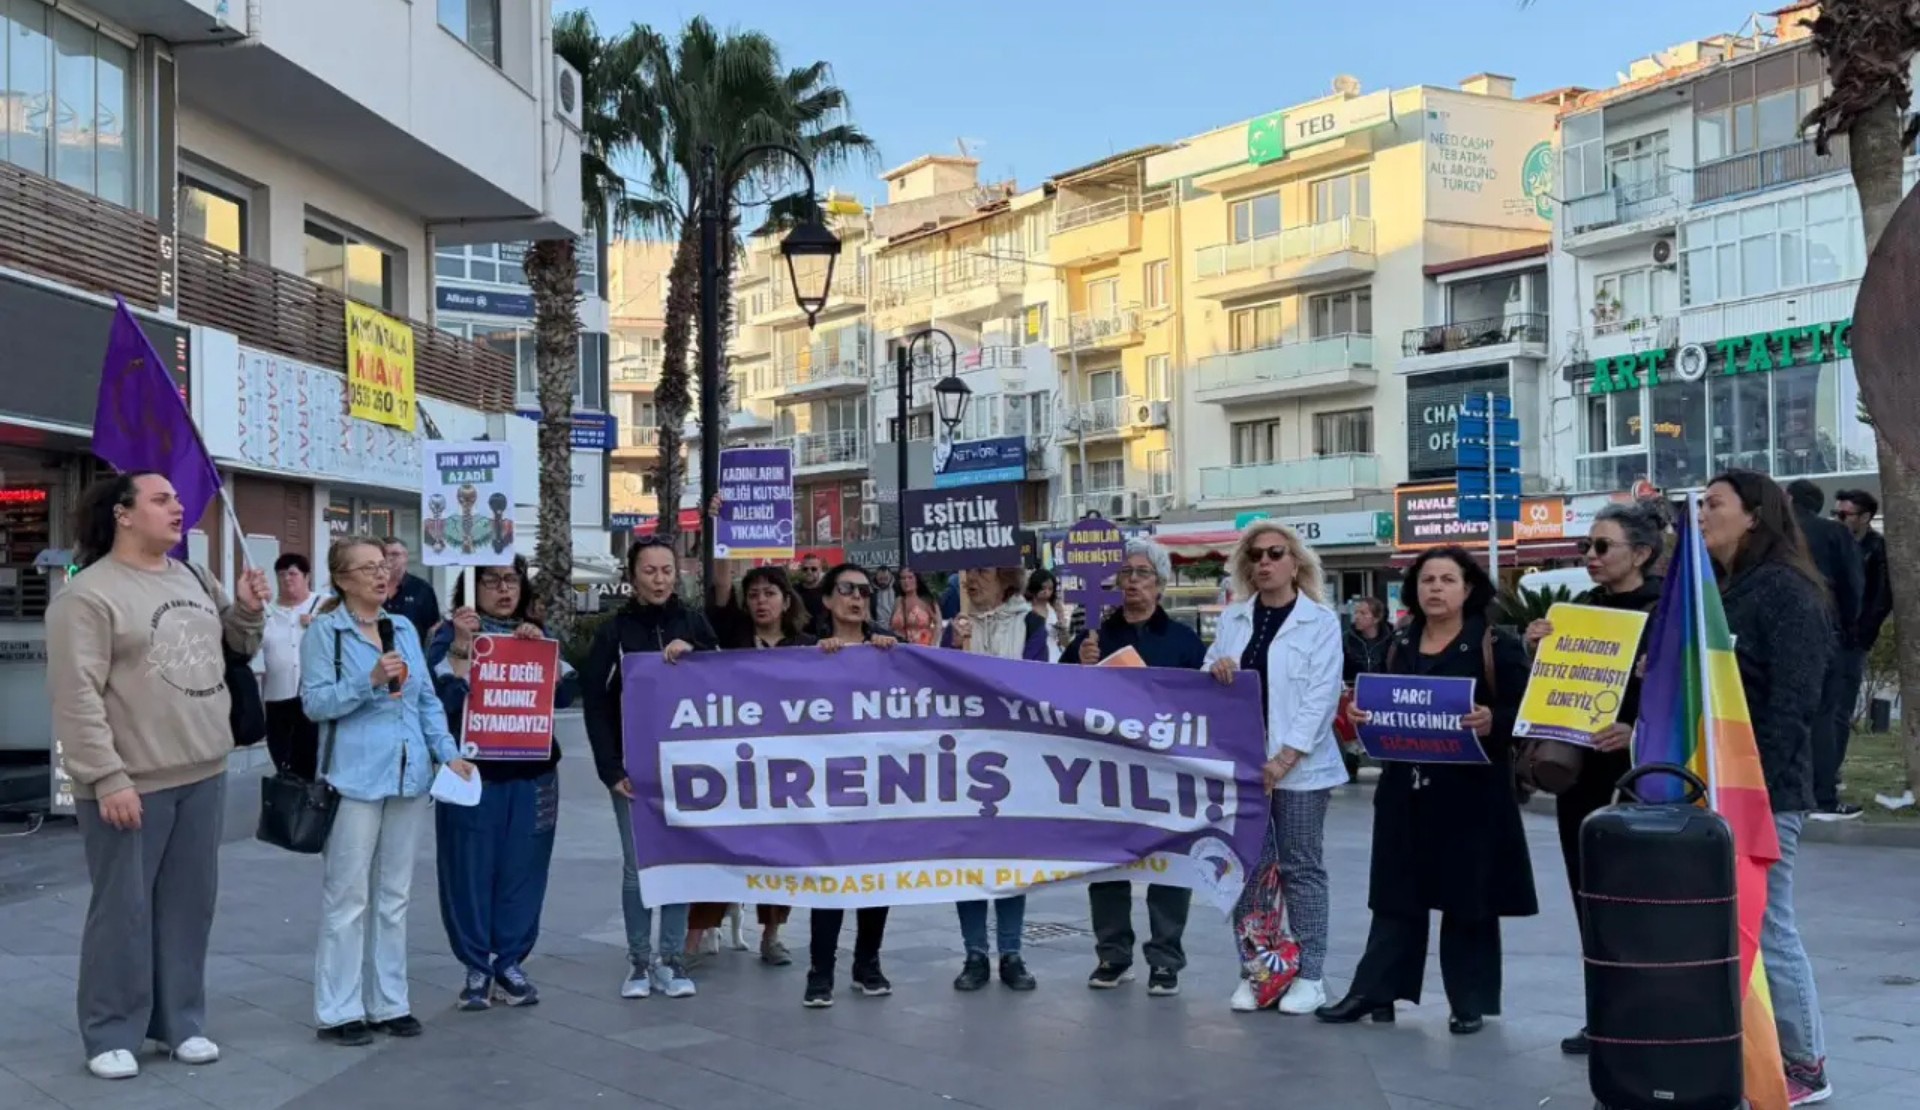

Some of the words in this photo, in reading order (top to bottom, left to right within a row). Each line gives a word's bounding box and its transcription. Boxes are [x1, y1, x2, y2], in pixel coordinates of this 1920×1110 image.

[1296, 113, 1336, 138] TEB
[1430, 132, 1459, 146] NEED
[1460, 135, 1494, 150] CASH?
[1440, 148, 1458, 161] TEB
[1430, 162, 1448, 175] ALL
[1450, 165, 1498, 181] AROUND
[1441, 177, 1484, 193] TURKEY
[1590, 348, 1668, 394] ART
[1717, 318, 1852, 376] TATTO
[440, 455, 459, 467] JIN
[952, 446, 998, 462] NETWORK
[722, 467, 785, 482] KADINLARIN
[753, 485, 793, 500] KUTSAL
[733, 503, 775, 520] AİLENİZİ
[923, 495, 998, 527] EŞİTLİK
[1407, 497, 1457, 511] HAVALE
[730, 525, 777, 540] YIKACAK
[1069, 529, 1120, 544] KADINLAR
[1414, 522, 1442, 536] EMİR
[1444, 518, 1489, 535] DÖVİZ'D
[910, 522, 1016, 553] ÖZGÜRLÜK
[1555, 634, 1621, 656] AİLENİZDEN
[479, 660, 507, 682] AİLE
[509, 661, 545, 683] DEĞİL
[1532, 658, 1569, 680] ÖTEYİZ
[483, 688, 538, 708] KADINIZ
[1392, 688, 1433, 706] YARGI
[1545, 689, 1594, 711] ÖZNEYİZ
[468, 710, 549, 734] İSYANDAYIZ!
[670, 693, 763, 729] Aile
[780, 698, 835, 724] ve
[852, 687, 985, 721] Nüfus
[998, 696, 1069, 728] Yılı
[1084, 707, 1208, 750] Değil
[1366, 710, 1463, 731] PAKETLERİNİZE
[672, 734, 1011, 818] DİRENİŞ
[1042, 755, 1226, 823] YILI!
[746, 873, 885, 896] KUŞADASI
[897, 869, 984, 889] KADIN
